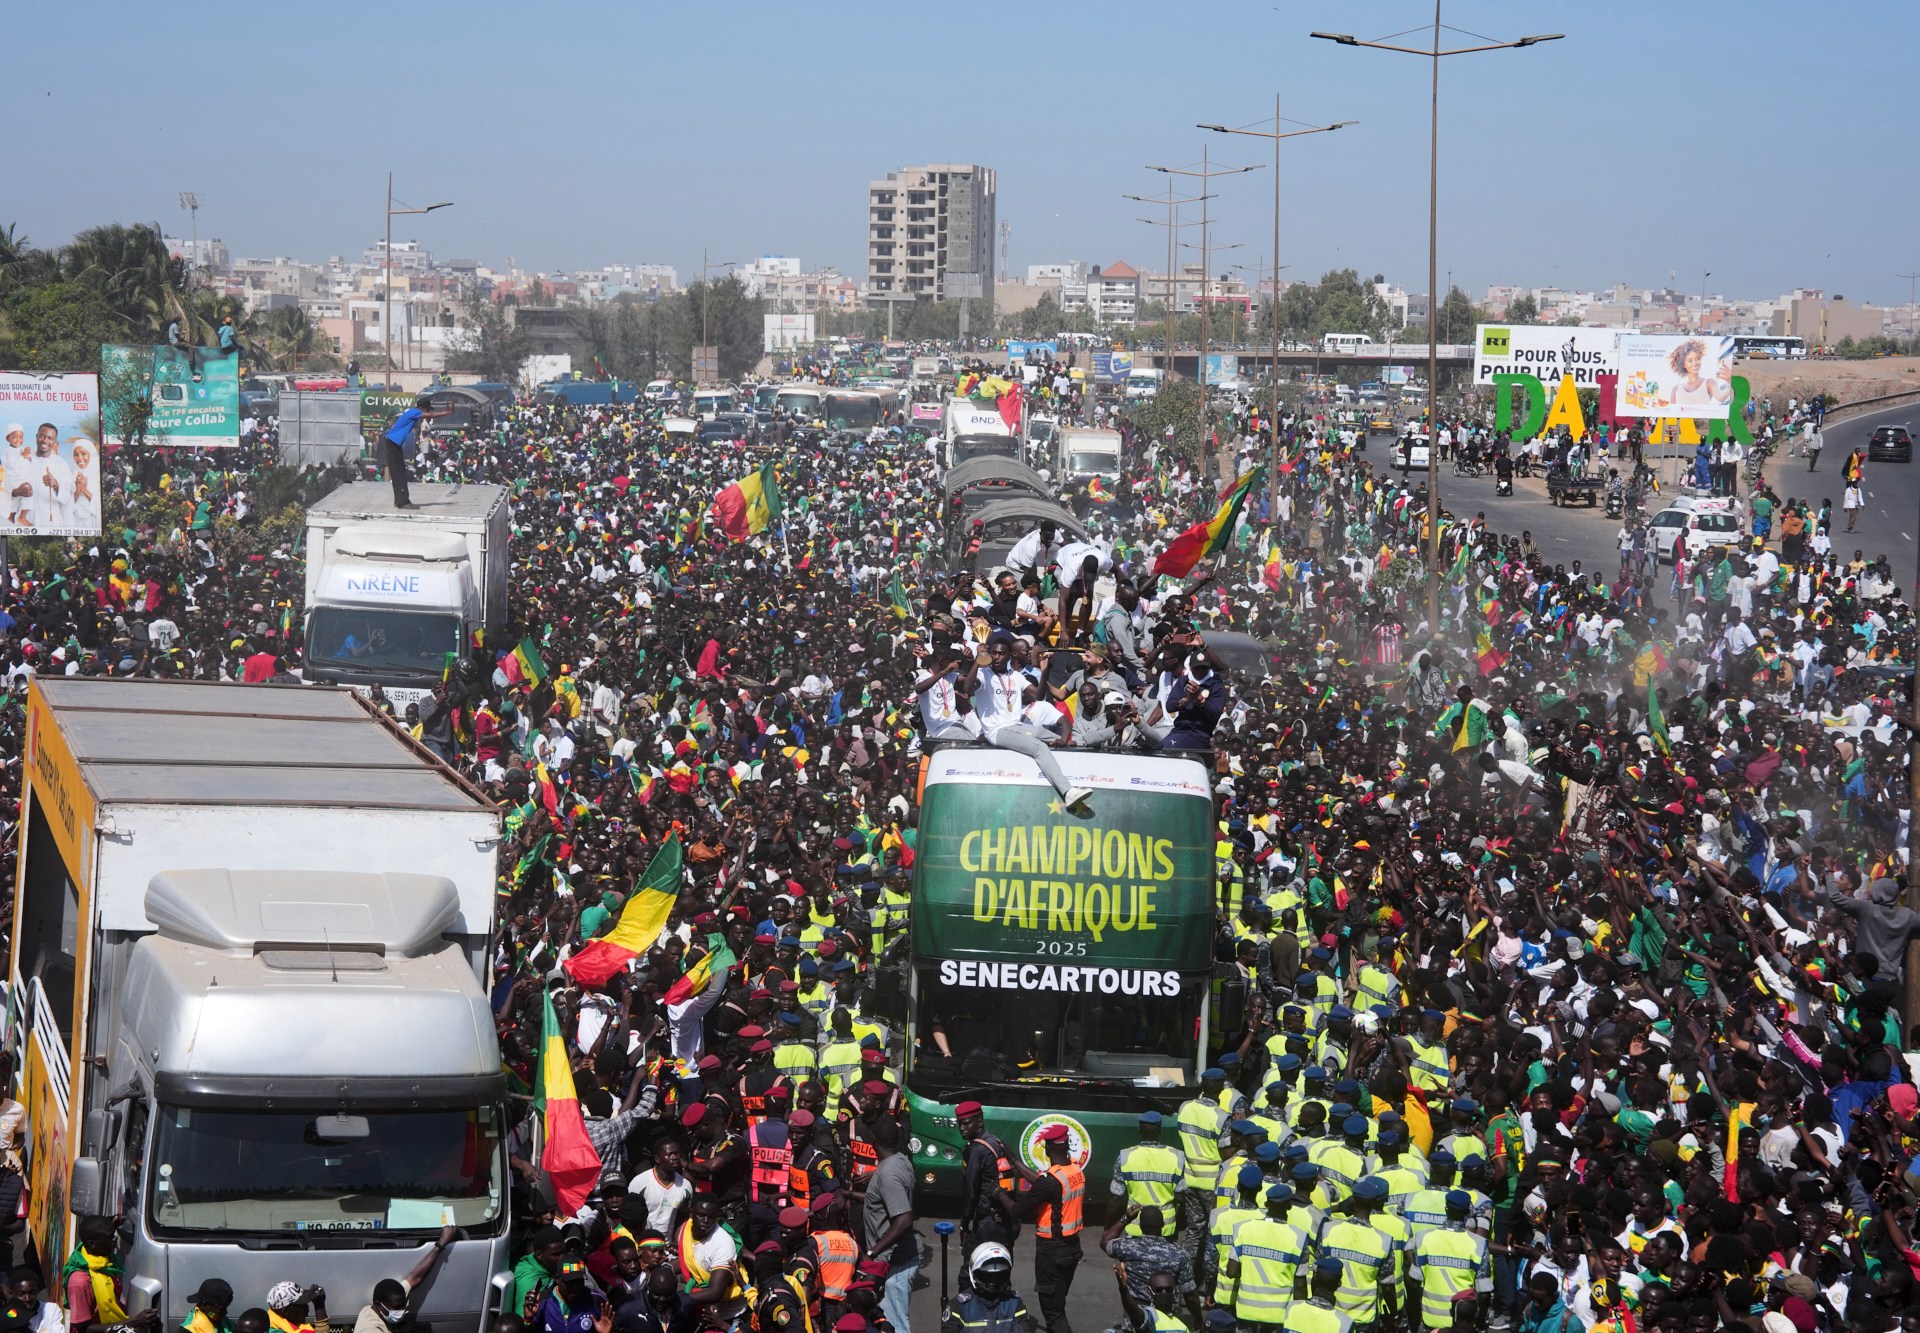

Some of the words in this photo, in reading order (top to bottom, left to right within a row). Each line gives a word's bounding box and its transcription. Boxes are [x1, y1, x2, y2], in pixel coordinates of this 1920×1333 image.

[1486, 338, 1510, 346] RT
[1515, 350, 1556, 362] POUR
[14, 392, 43, 401] MAGAL
[46, 392, 57, 401] DE
[60, 393, 88, 402] TOUBA
[365, 396, 378, 406] CI
[383, 397, 412, 406] KAW
[188, 406, 224, 414] encaisse
[185, 413, 225, 426] Collab
[347, 573, 420, 592] KIRÈNE
[960, 826, 1175, 881] CHAMPIONS
[974, 878, 1157, 942] D'AFRIQUE
[1036, 941, 1086, 956] 2025
[940, 960, 1181, 996] SENECARTOURS
[754, 1150, 790, 1161] POLICE
[1331, 1248, 1376, 1266] GENDARMERIE
